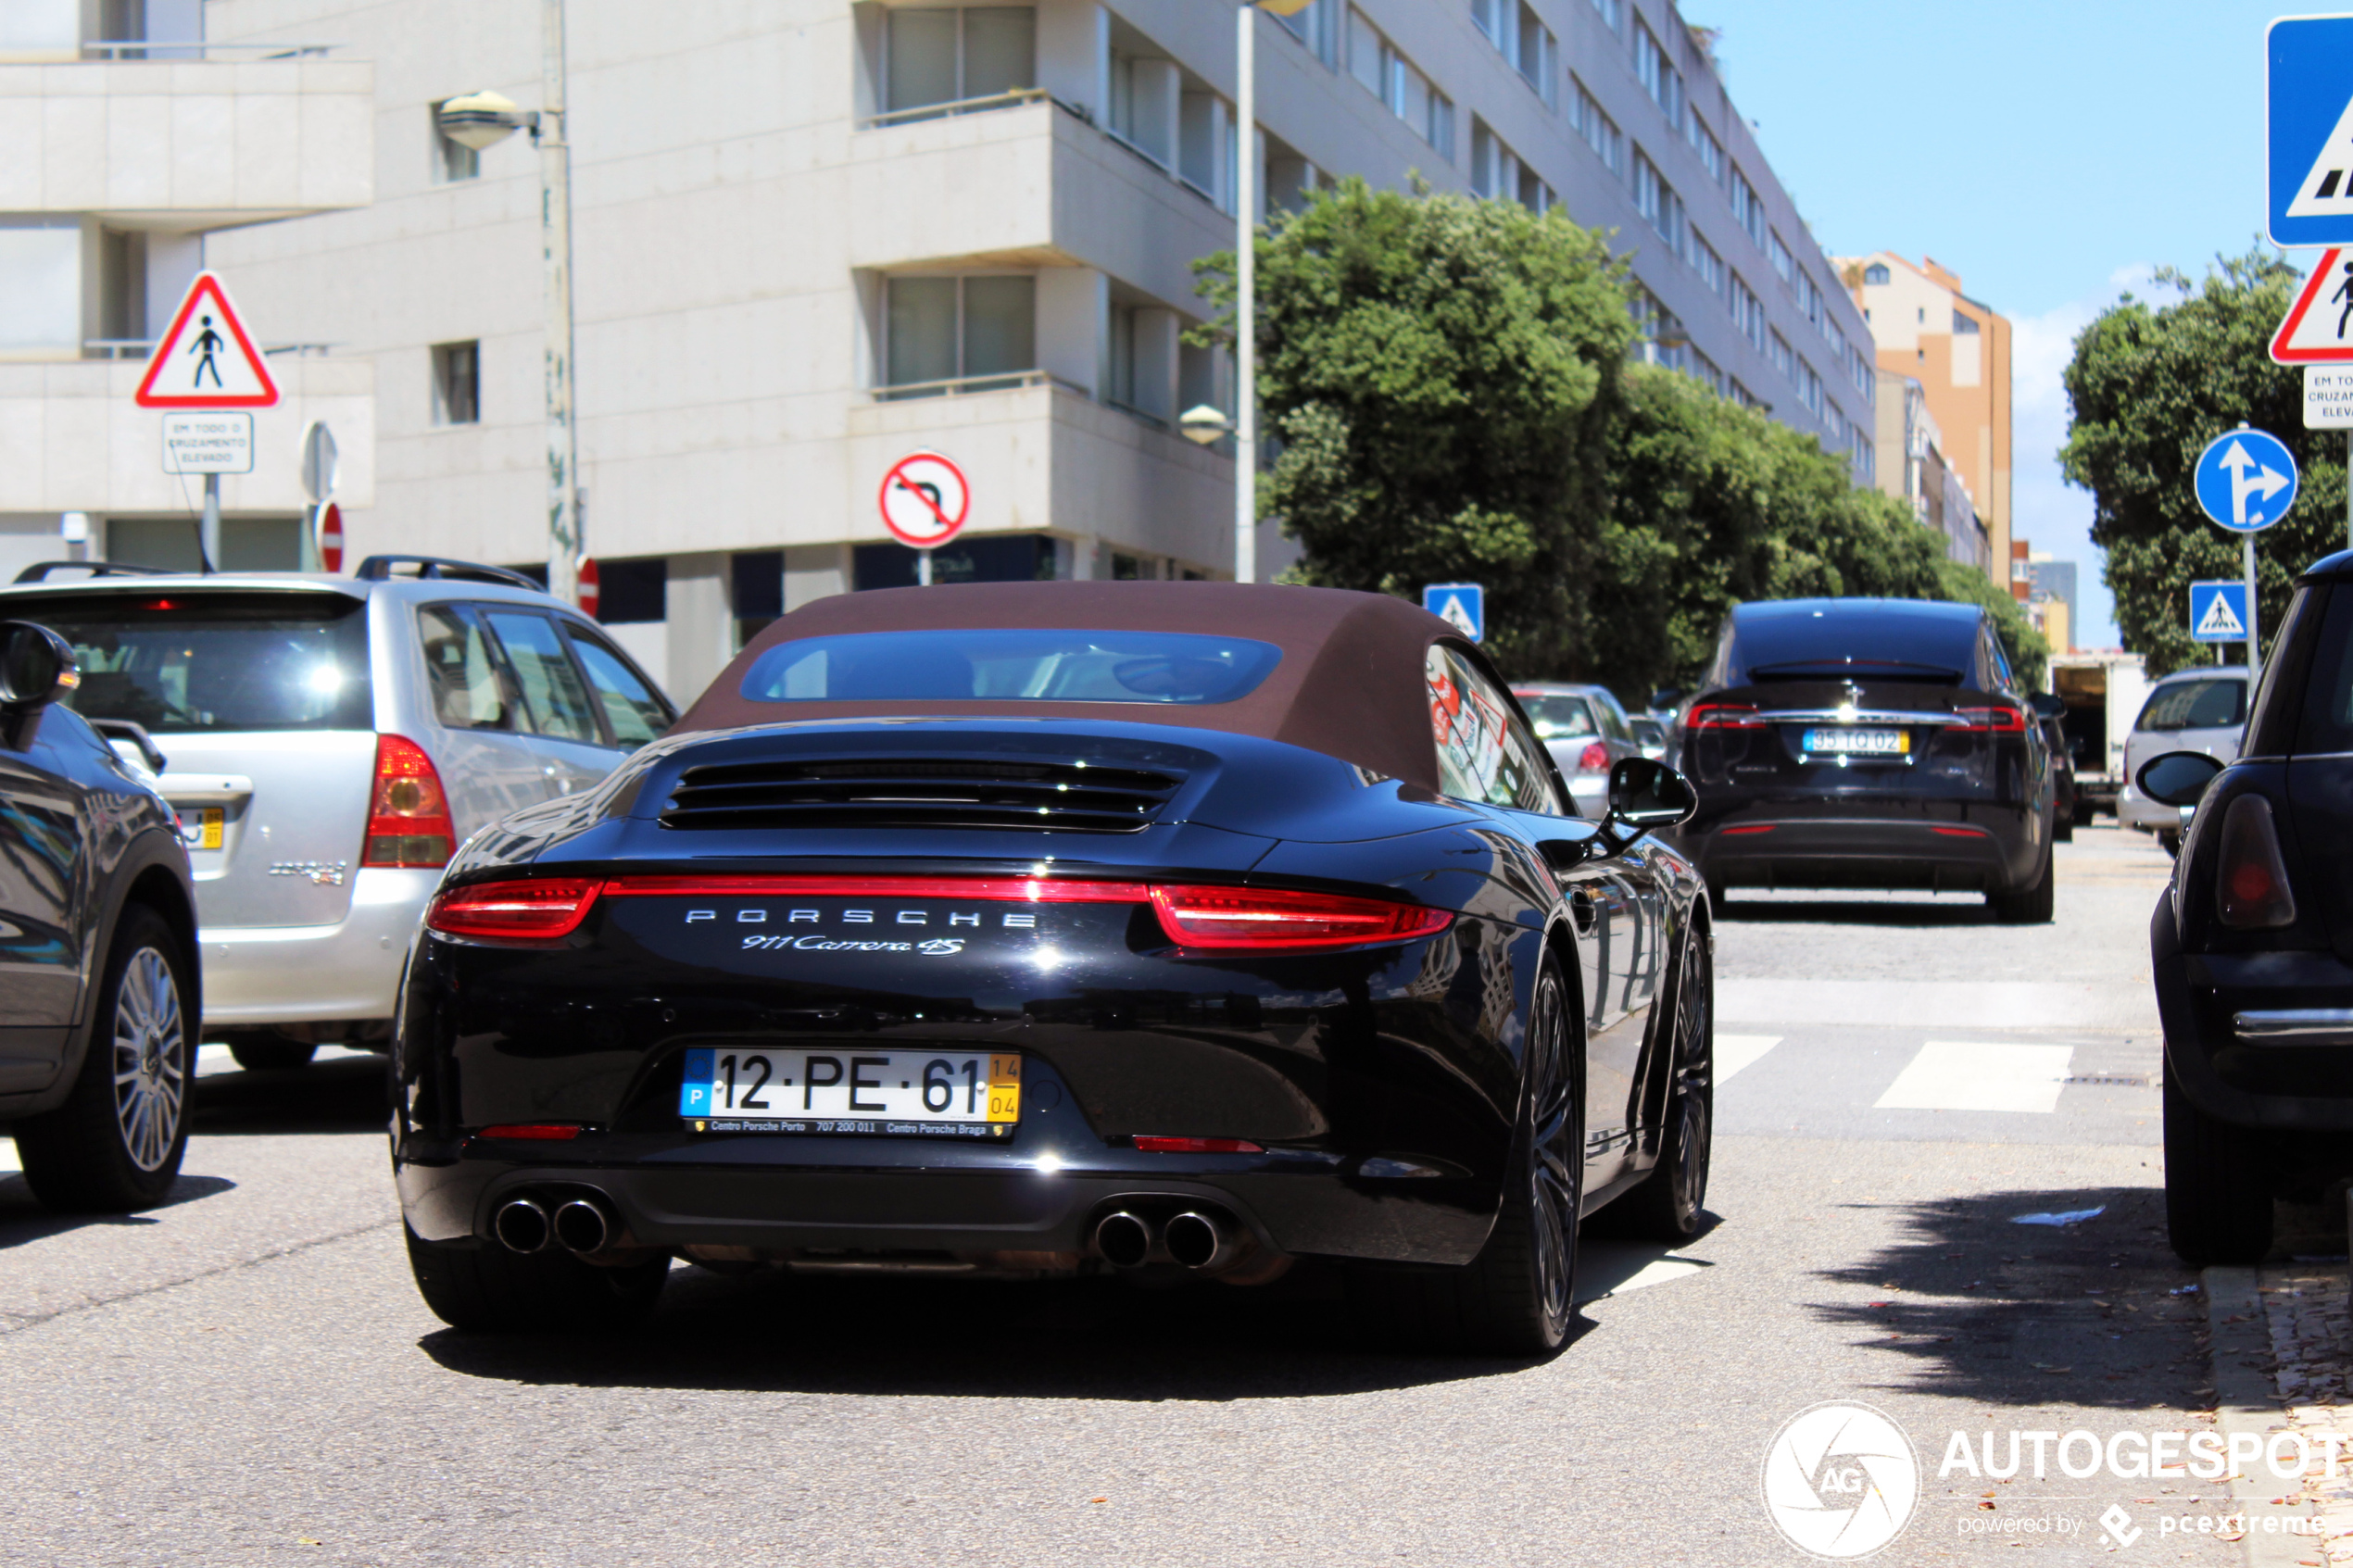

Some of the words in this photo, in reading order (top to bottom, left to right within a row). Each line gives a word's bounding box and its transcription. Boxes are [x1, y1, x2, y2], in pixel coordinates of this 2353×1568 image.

[2314, 376, 2331, 386] EM
[2322, 408, 2353, 418] ELEV
[173, 424, 189, 433] EM
[195, 424, 227, 433] TODO
[232, 423, 241, 433] O
[169, 438, 246, 447] CRUZAMENTO
[182, 453, 233, 462] ELEVADO
[685, 909, 1036, 928] PORSCHE
[741, 935, 794, 950] 911
[792, 935, 912, 952] Carrera
[917, 938, 966, 958] 4S
[993, 1059, 1018, 1078] 14
[690, 1089, 703, 1105] P
[991, 1097, 1015, 1115] 04
[711, 1121, 741, 1132] Centro
[743, 1121, 779, 1132] Porsche
[781, 1121, 806, 1132] Porto
[816, 1122, 834, 1132] 707
[837, 1122, 855, 1132] 200
[858, 1122, 875, 1133] 011
[887, 1123, 917, 1134] Centro
[919, 1123, 956, 1135] Porsche
[958, 1124, 987, 1136] Braga
